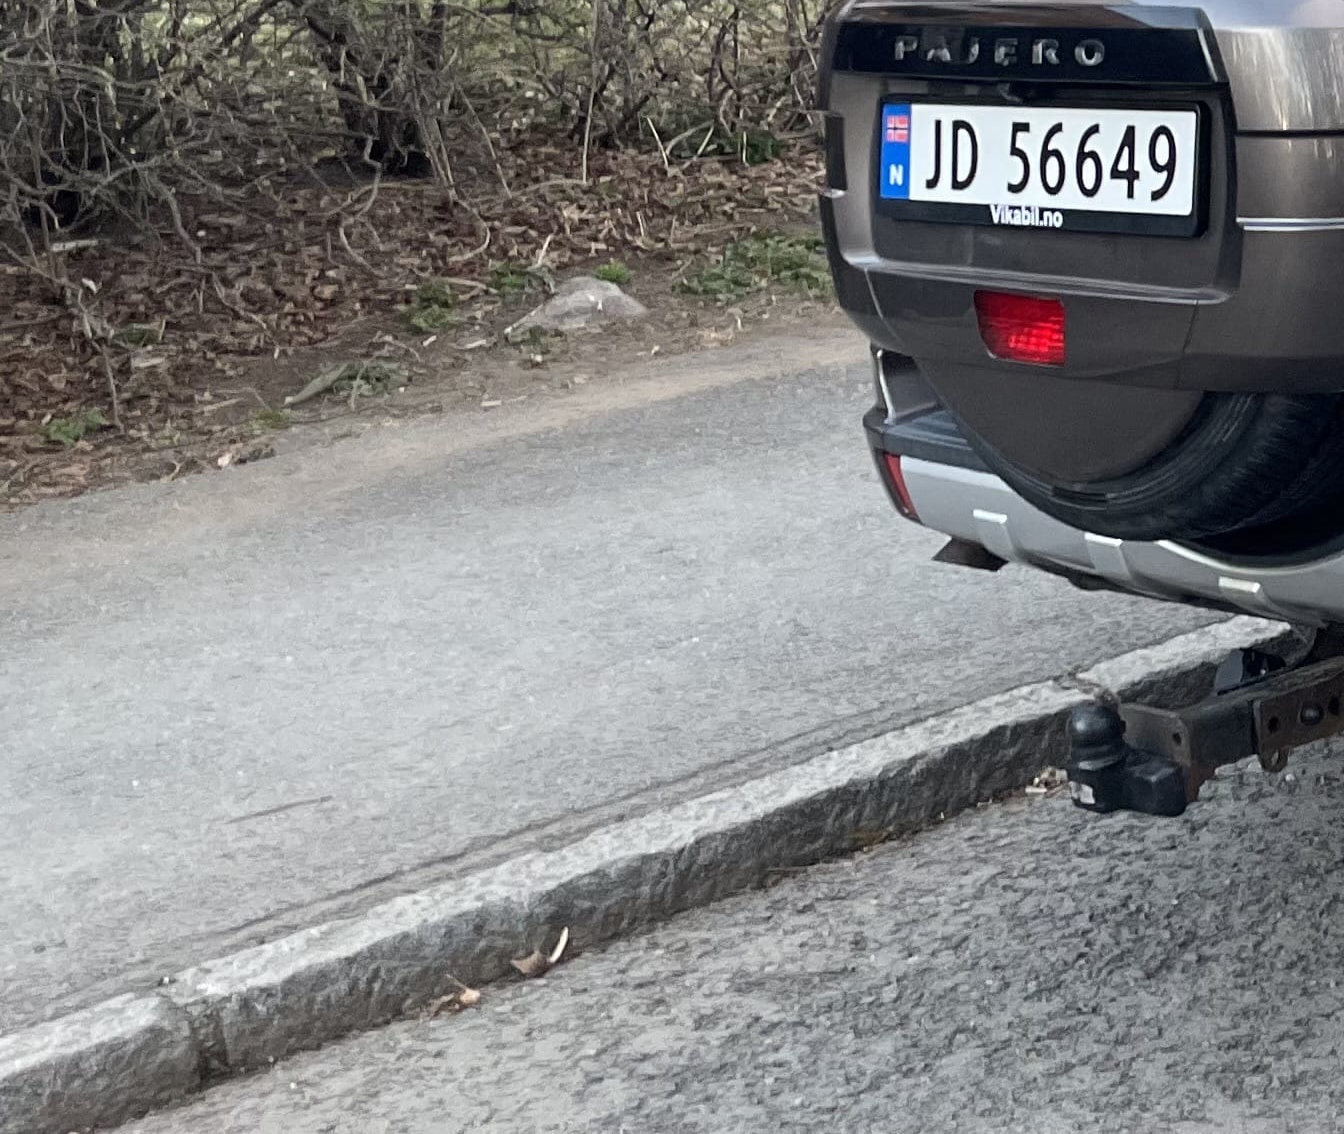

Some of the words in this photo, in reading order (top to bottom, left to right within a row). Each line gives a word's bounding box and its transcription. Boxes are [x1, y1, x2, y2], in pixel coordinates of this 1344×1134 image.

[894, 35, 1106, 67] PAJERO
[889, 163, 904, 186] N
[925, 119, 979, 191] JD
[1007, 121, 1177, 202] 56649
[989, 204, 1063, 228] Vikabil.no
